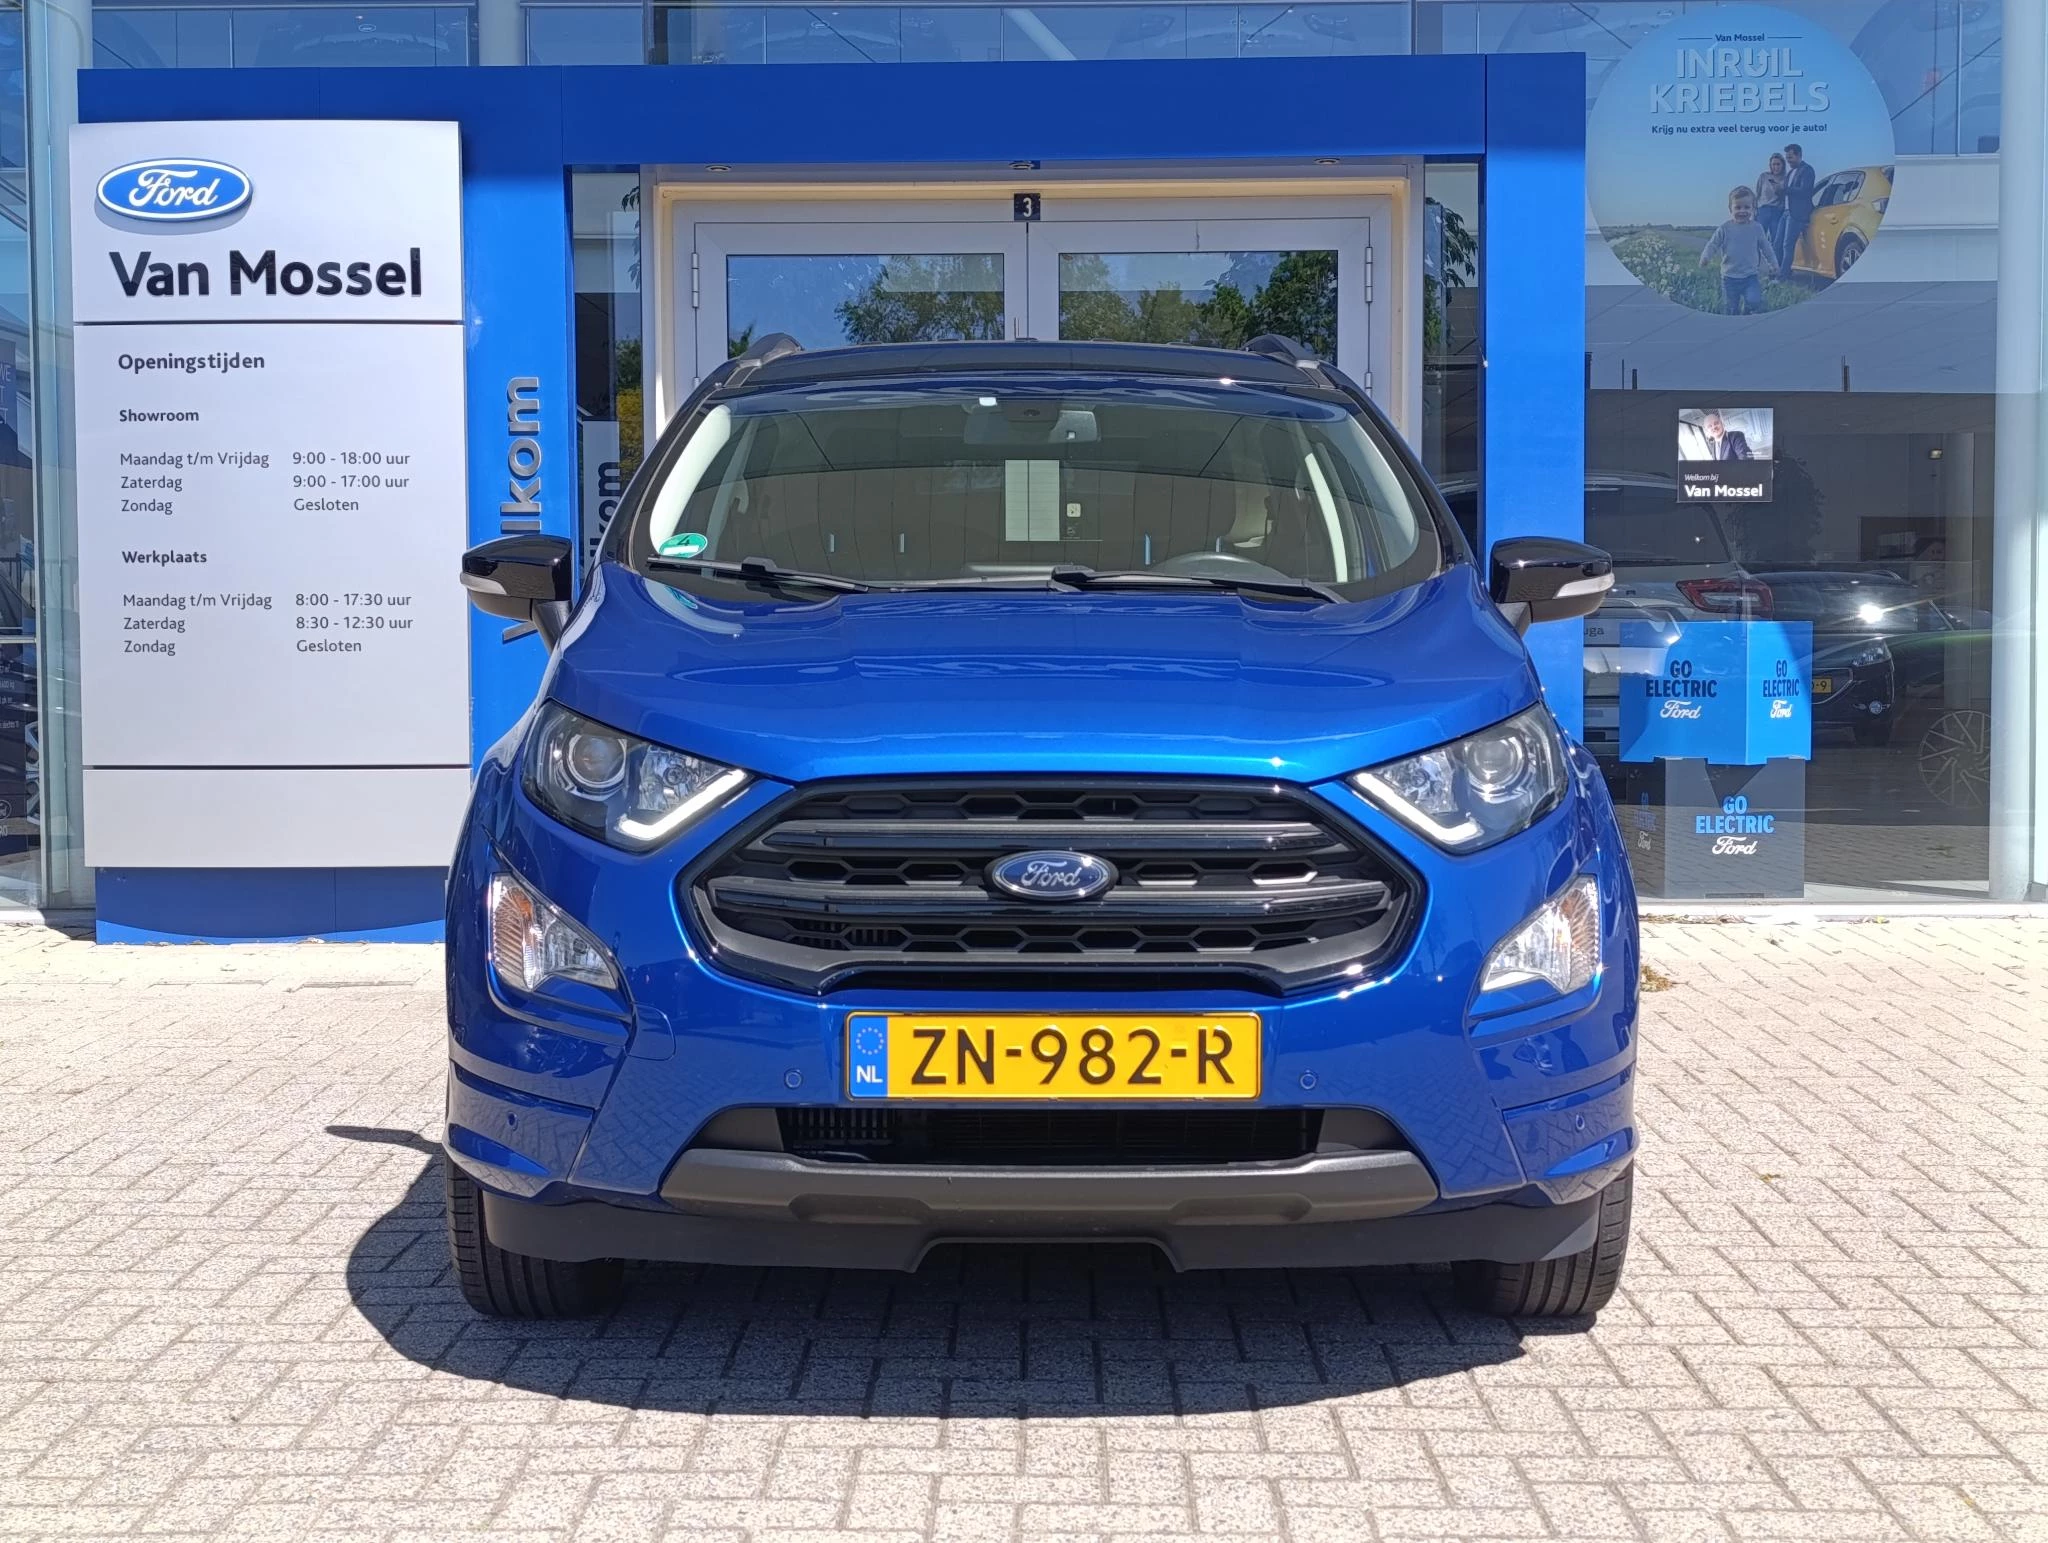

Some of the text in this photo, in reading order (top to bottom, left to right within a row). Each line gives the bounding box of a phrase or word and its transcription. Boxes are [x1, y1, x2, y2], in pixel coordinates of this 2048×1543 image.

[1715, 33, 1765, 42] Van Mossel
[1676, 48, 1803, 78] INRUIL
[1651, 82, 1831, 113] KRIEBELS
[1652, 125, 1674, 135] Krijg
[1718, 124, 1737, 132] veel
[1740, 126, 1765, 134] terug
[1791, 124, 1800, 133] je
[1803, 124, 1827, 132] auto!
[129, 169, 221, 206] Ford
[1023, 197, 1032, 218] 3
[109, 248, 421, 296] Van Mossel
[118, 352, 264, 374] Openingstijden
[120, 409, 199, 422] Showroom
[121, 452, 183, 468] Maandag
[187, 452, 213, 465] t/m
[218, 452, 269, 468] Vrijdag
[293, 452, 325, 464] 9:00
[341, 452, 381, 464] 18:00
[386, 456, 410, 464] uur
[121, 476, 182, 492] Zaterdag
[293, 475, 326, 487] 9:00
[341, 475, 380, 487] 17:00
[386, 479, 409, 487] uur
[1711, 474, 1719, 482] bij
[1684, 484, 1762, 497] Van Mossel
[121, 498, 358, 515] Zondag Gesloten
[122, 550, 207, 567] Werkplaats
[124, 594, 186, 610] Maandag
[190, 594, 216, 606] t/m
[220, 593, 272, 610] Vrijdag
[296, 594, 328, 605] 8:00
[344, 594, 382, 605] 17:30
[388, 597, 411, 605] uur
[124, 617, 185, 633] Zaterdag
[297, 617, 328, 629] 8:30
[344, 616, 384, 628] 12:30
[389, 620, 413, 628] uur
[124, 639, 361, 656] Zondag Gesloten
[1670, 660, 1692, 678] GO
[1776, 660, 1788, 678] GO
[1645, 679, 1717, 697] ELECTRIC
[1763, 679, 1799, 697] ELECTRIC
[1660, 700, 1701, 719] Ford
[1770, 700, 1792, 718] Ford
[1722, 796, 1747, 815] GO
[1696, 815, 1775, 834] ELECTRIC
[1712, 835, 1757, 855] Ford
[1021, 861, 1082, 888] Ford
[911, 1025, 1234, 1086] ZN-982-R
[857, 1065, 883, 1082] NL
